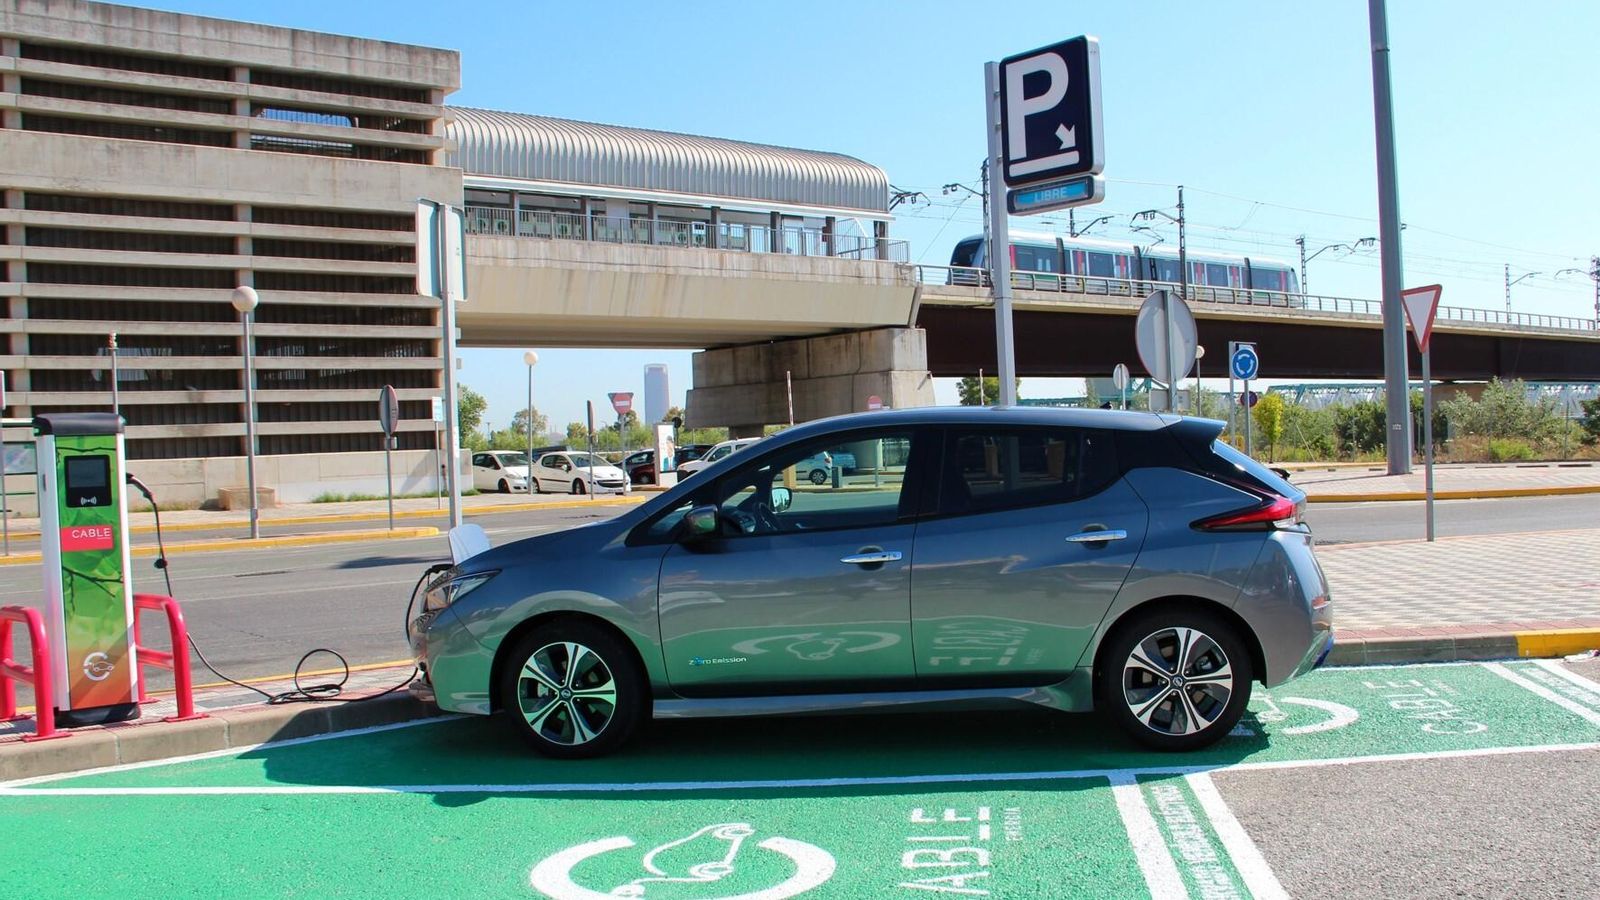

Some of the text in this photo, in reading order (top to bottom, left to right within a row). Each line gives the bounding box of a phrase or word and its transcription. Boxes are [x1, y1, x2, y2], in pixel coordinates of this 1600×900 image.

[1006, 52, 1069, 161] P
[1034, 186, 1069, 202] LIBRE
[72, 528, 111, 538] CABLE
[712, 656, 747, 664] Emission
